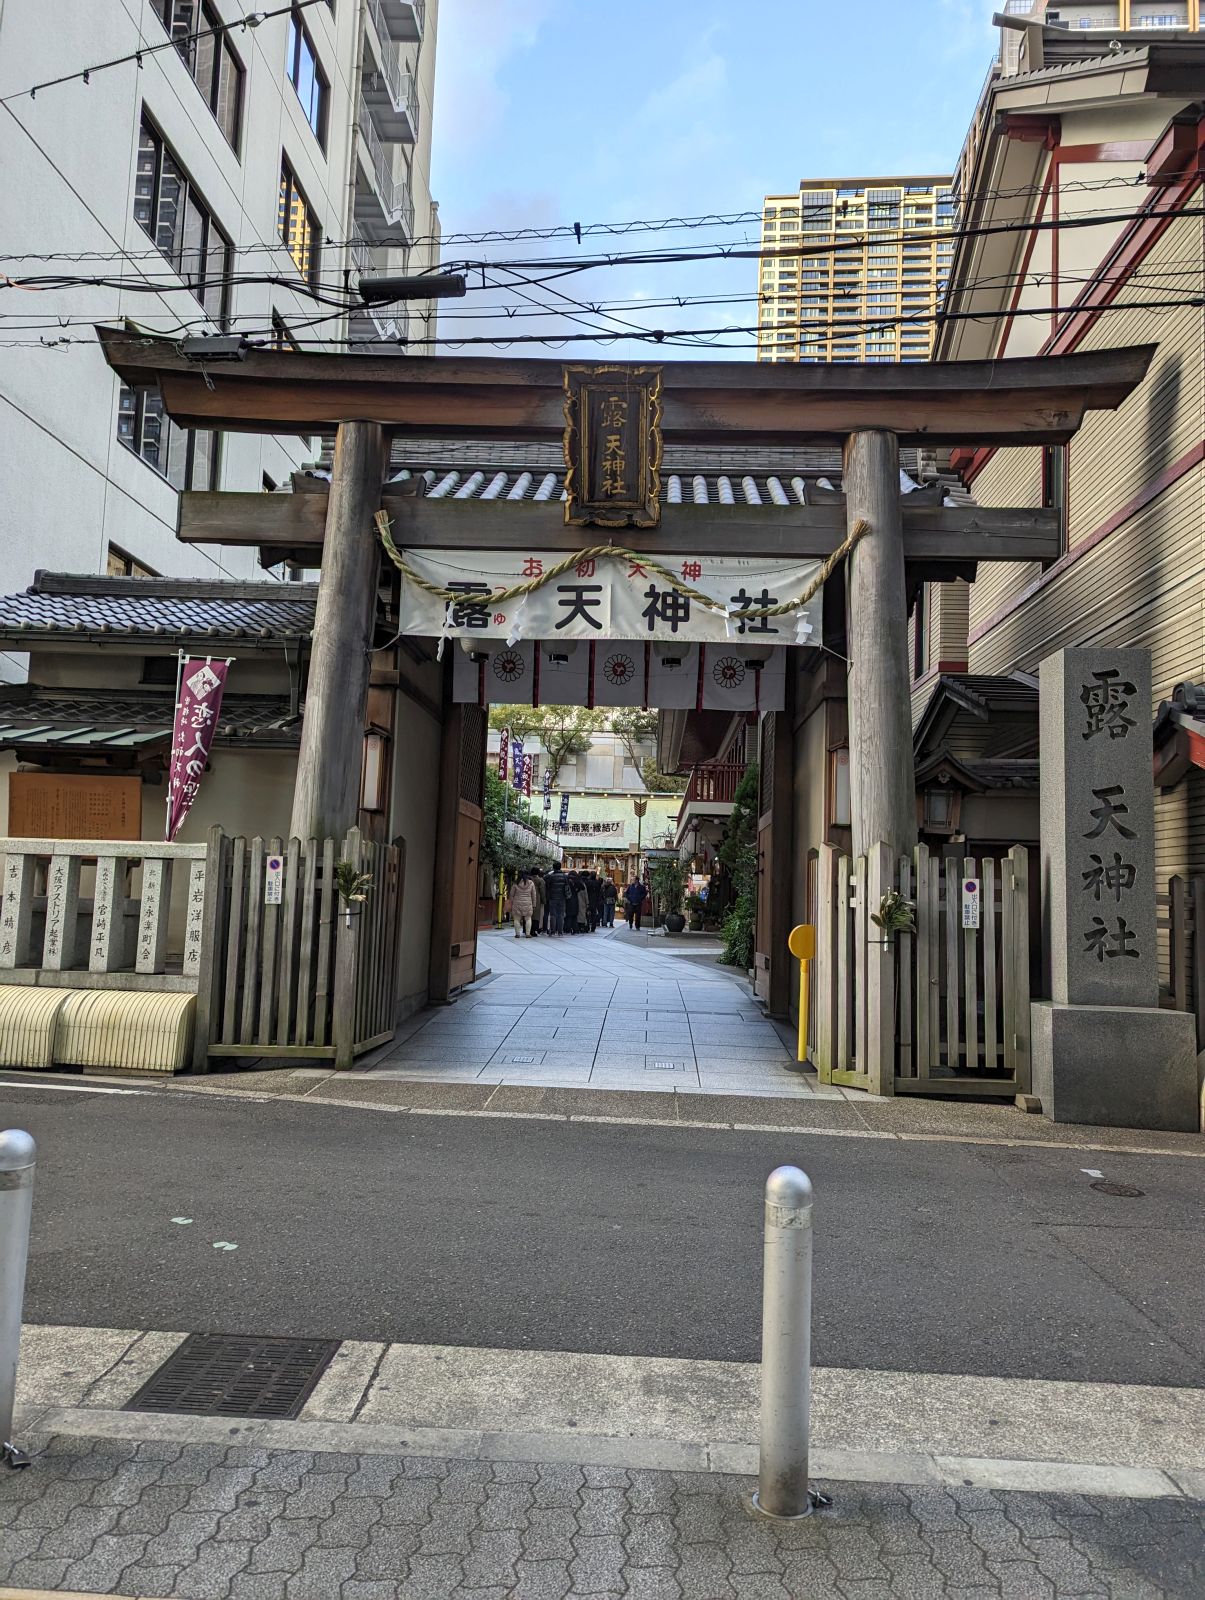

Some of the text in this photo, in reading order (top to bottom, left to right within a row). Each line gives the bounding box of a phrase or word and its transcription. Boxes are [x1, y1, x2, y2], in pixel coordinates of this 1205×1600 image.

[600, 396, 628, 495] 露天神社
[443, 581, 780, 634] 露天神社
[1079, 668, 1141, 963] 露天神社
[187, 870, 205, 962] 平岩洋服店
